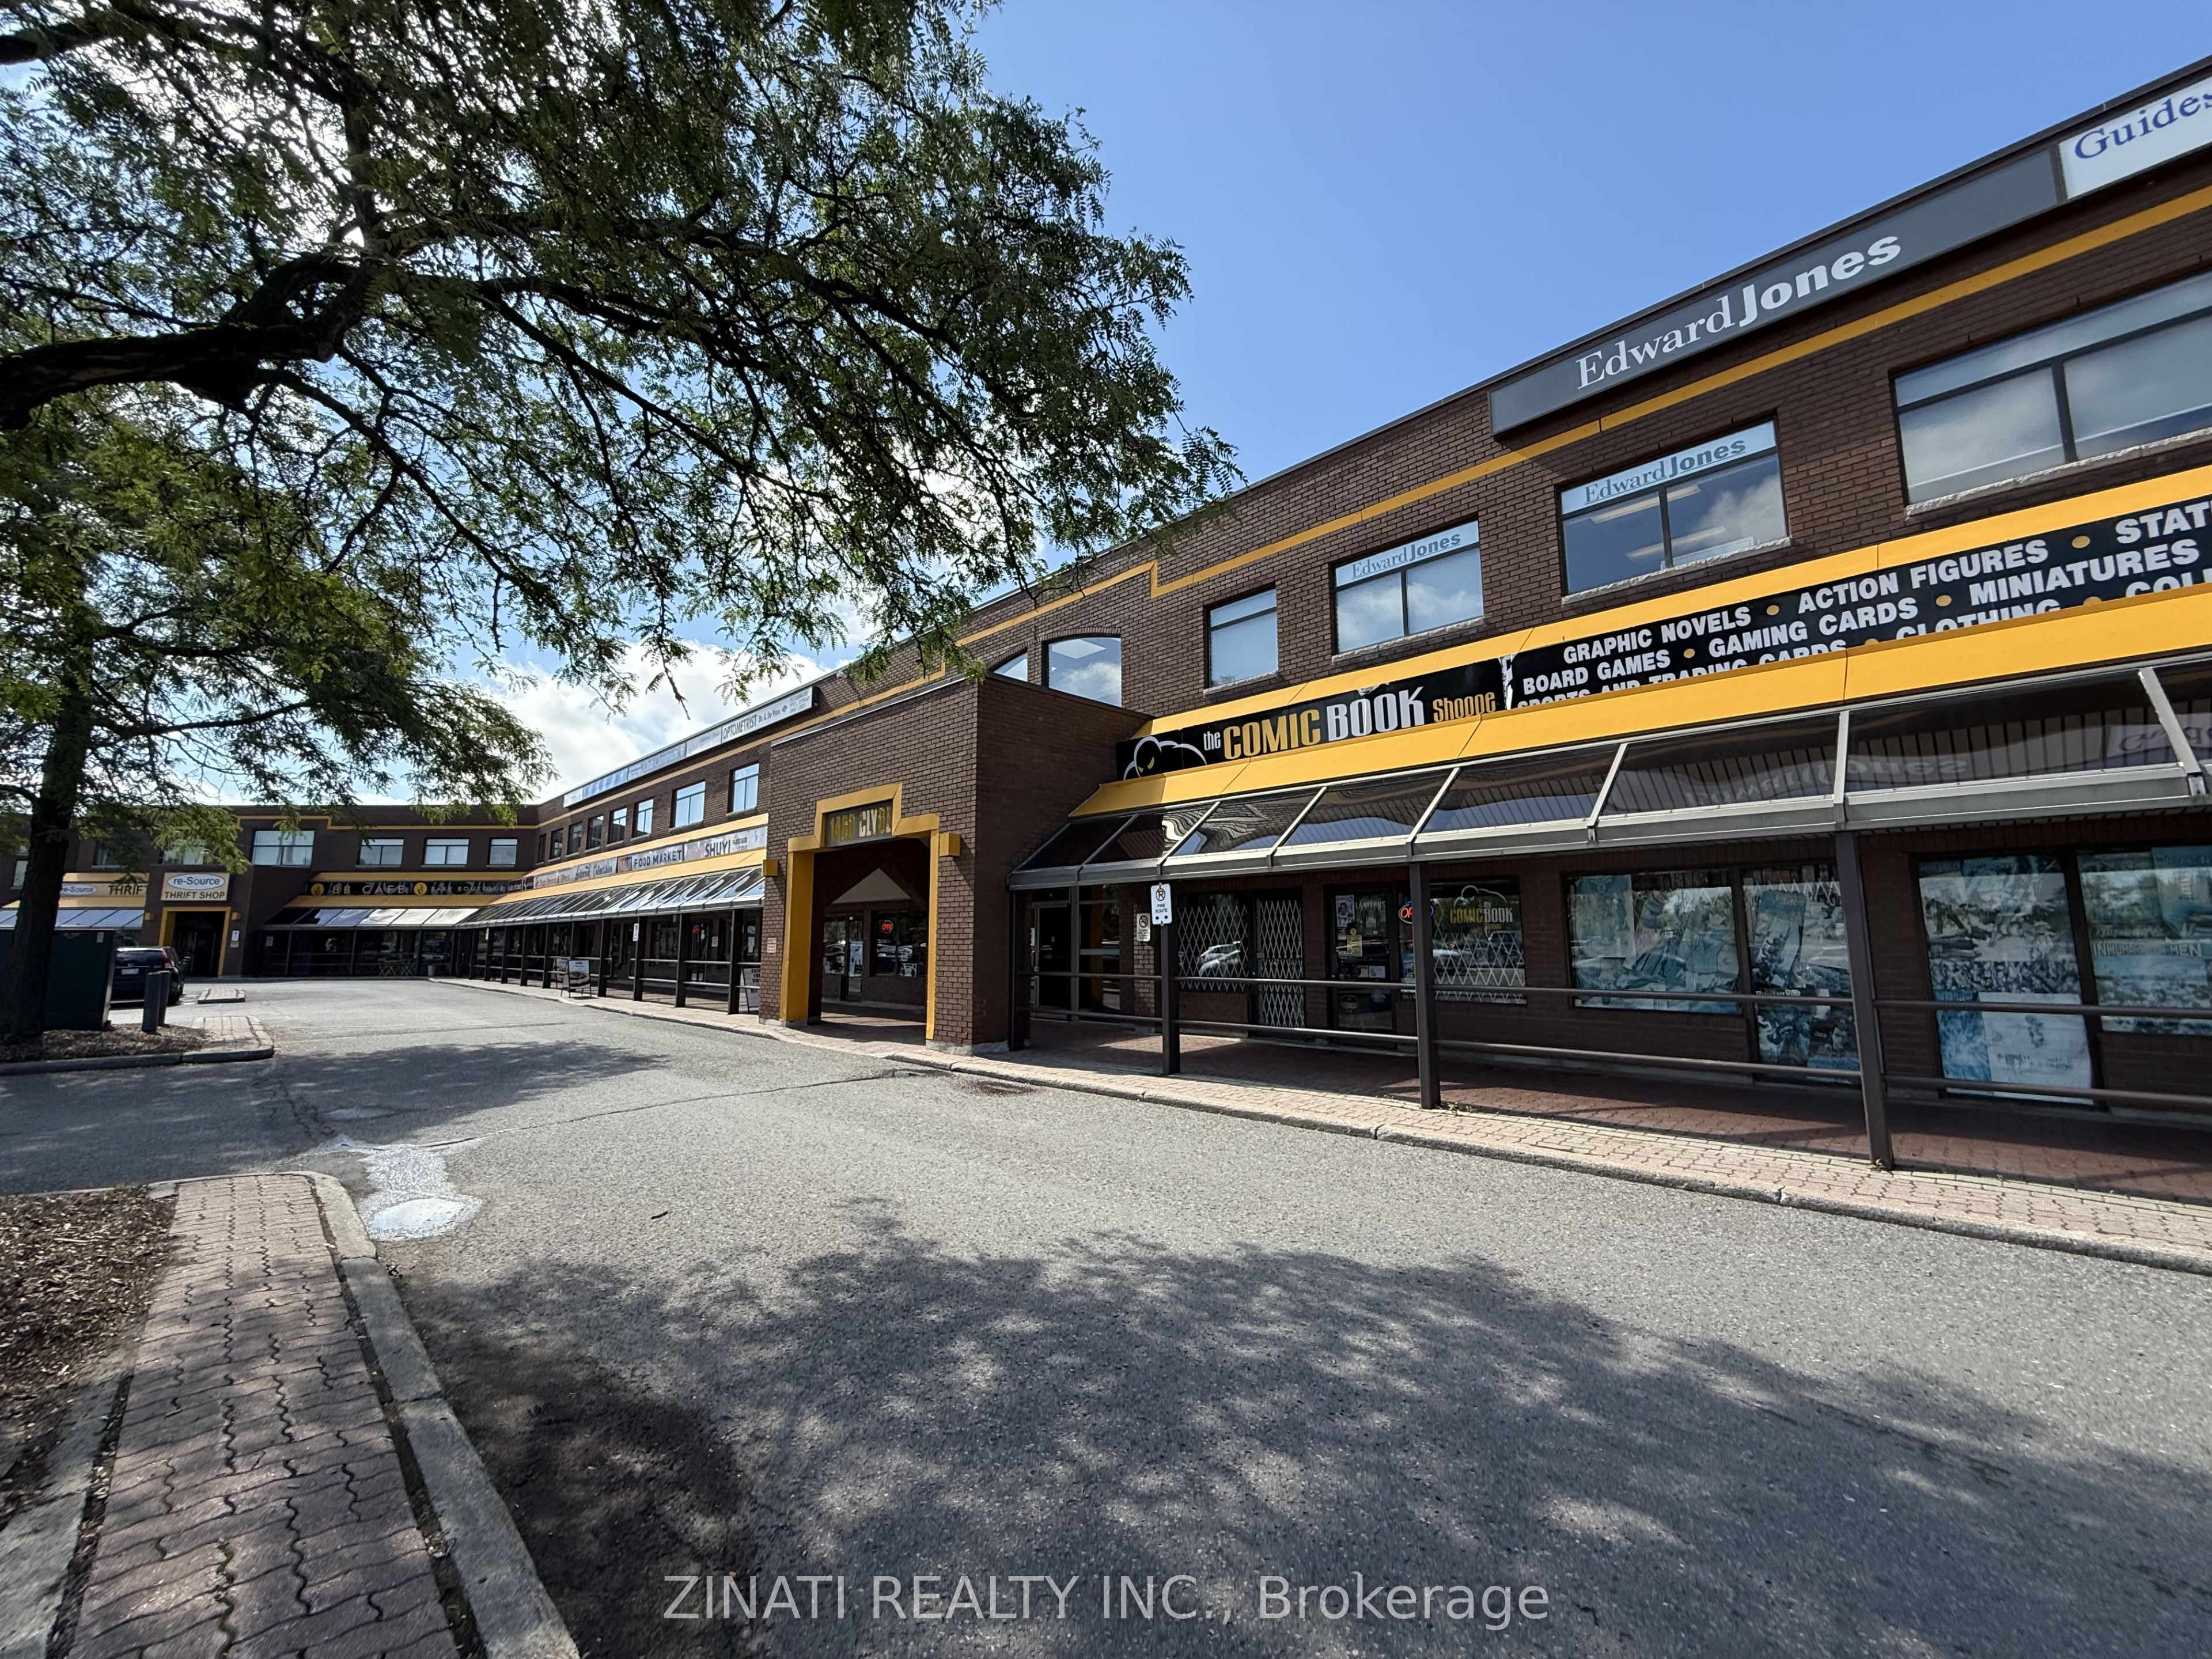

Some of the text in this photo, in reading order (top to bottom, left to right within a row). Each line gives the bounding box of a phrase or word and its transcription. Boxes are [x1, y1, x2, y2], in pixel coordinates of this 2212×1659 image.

[1563, 499, 2212, 664] GRAPHIC NOVELS ACTION FIGURES STAT
[1522, 538, 2200, 695] BOARD GAMES GAMING CARDS MINIATURES
[723, 714, 758, 740] OPTOMETRIST
[1203, 730, 1221, 751] the
[1224, 709, 1321, 760] COMIC
[1327, 685, 1425, 742] BOOK
[704, 839, 730, 858] SHUYI
[634, 856, 651, 868] FOOD
[653, 850, 682, 865] MARKET
[173, 876, 220, 885] re-Source
[164, 891, 225, 899] THRIFT SHOP
[1449, 907, 1513, 923] COMIC BOOK
